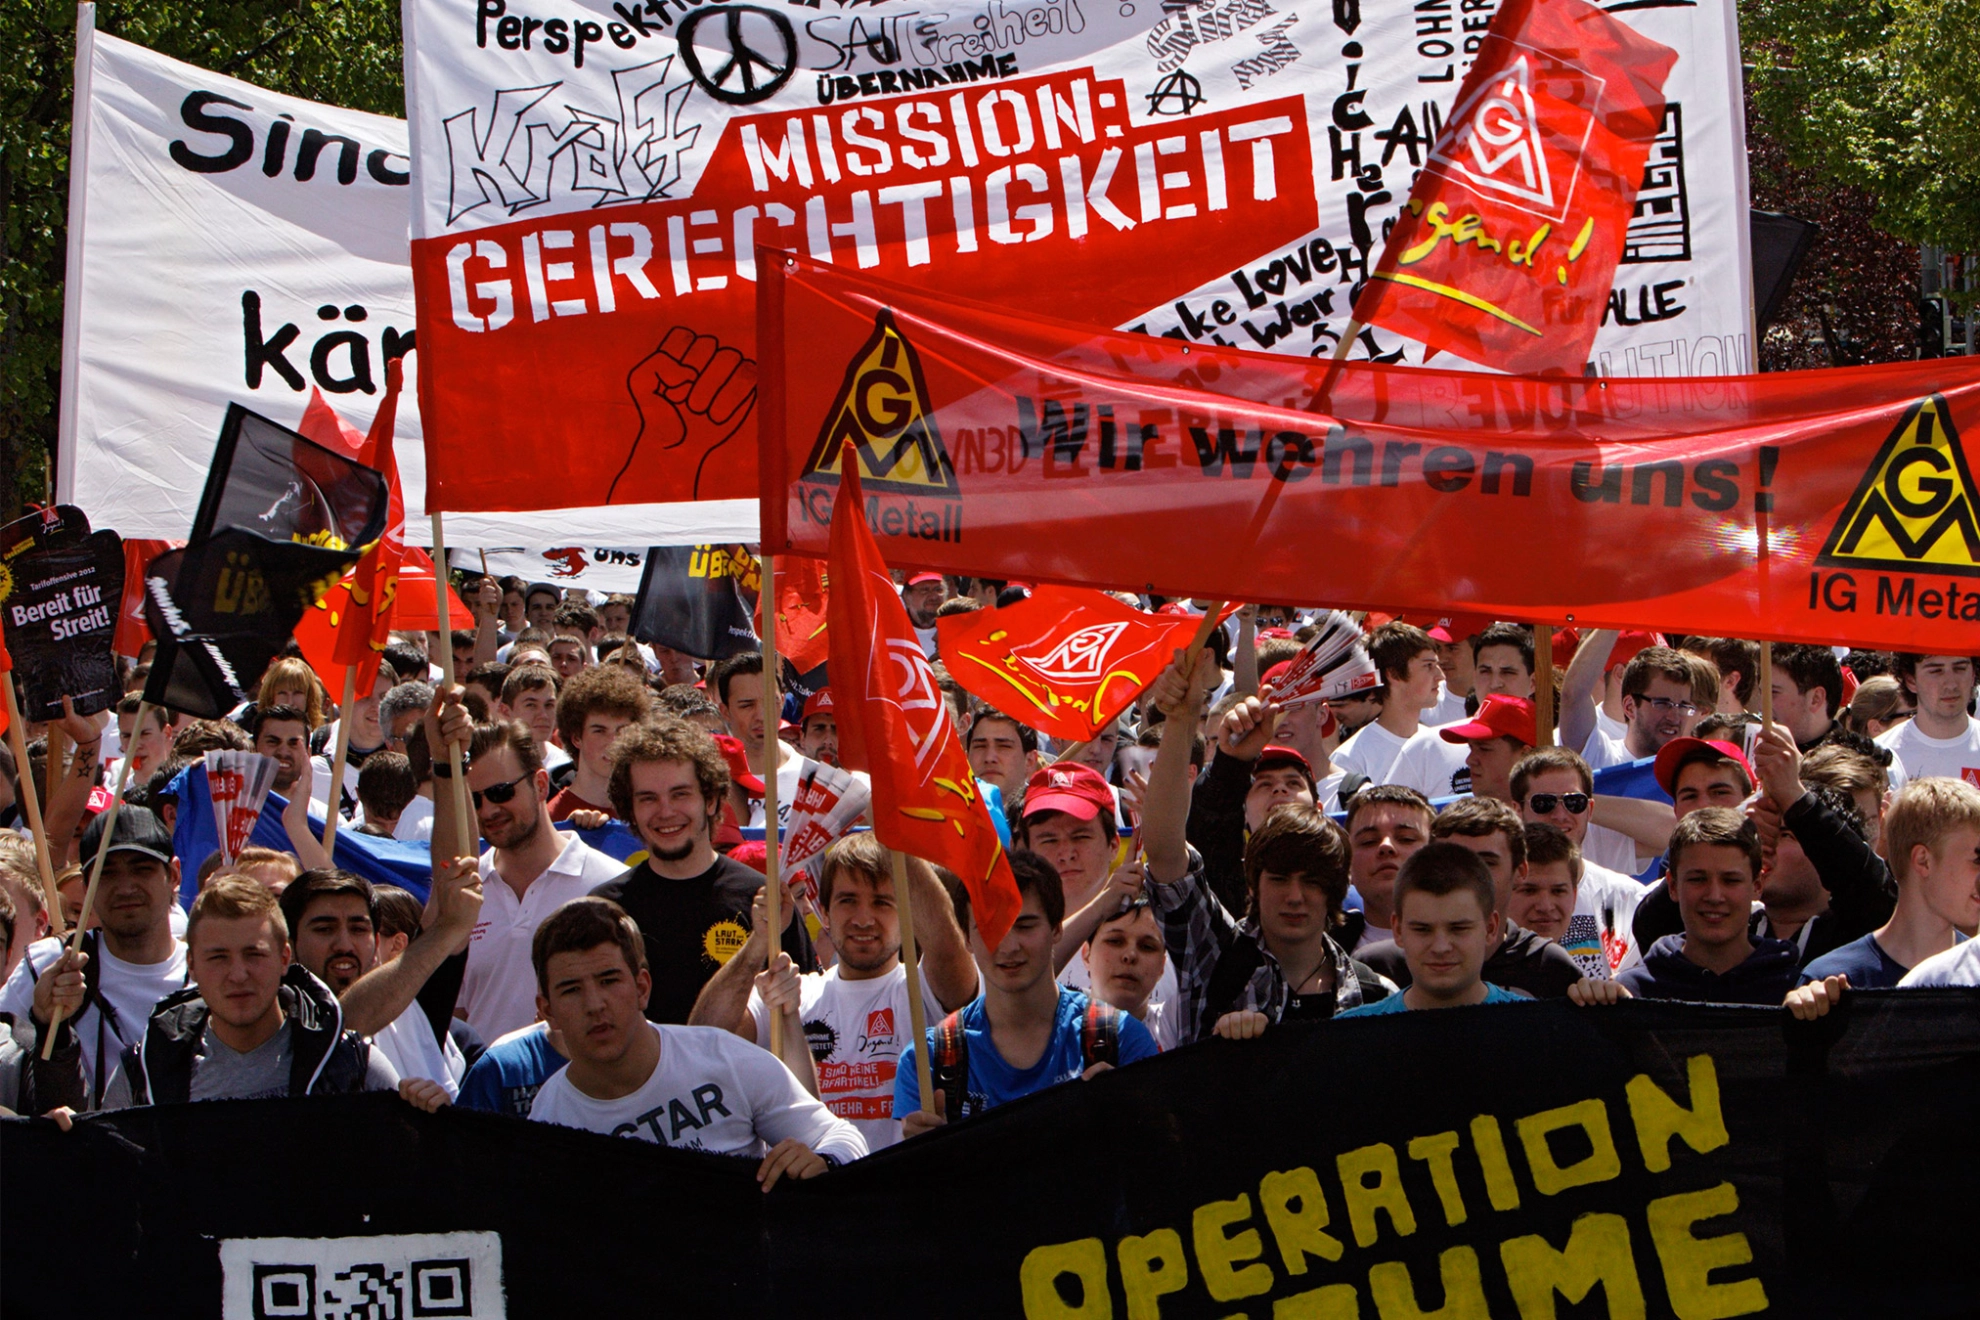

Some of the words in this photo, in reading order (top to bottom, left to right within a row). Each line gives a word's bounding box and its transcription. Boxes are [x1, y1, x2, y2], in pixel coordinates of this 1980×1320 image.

[817, 54, 1018, 104] ÜBERNAHME
[739, 78, 1125, 192] MISSION:
[445, 116, 1293, 333] GERECHTIGKEIT
[1015, 395, 1159, 471] Wir
[1188, 424, 1535, 498] wehren
[1569, 446, 1780, 513] uns!
[30, 571, 78, 591] Tarifoffensive
[78, 566, 96, 577] 2012
[1809, 571, 1857, 612] IG
[11, 592, 72, 627] Bereit
[73, 584, 102, 609] für
[51, 605, 111, 641] Streit!
[715, 930, 736, 938] LAUT
[715, 938, 743, 946] STARK
[819, 1076, 880, 1089] RFARTIKEL!
[1020, 1053, 1730, 1320] OPERATION
